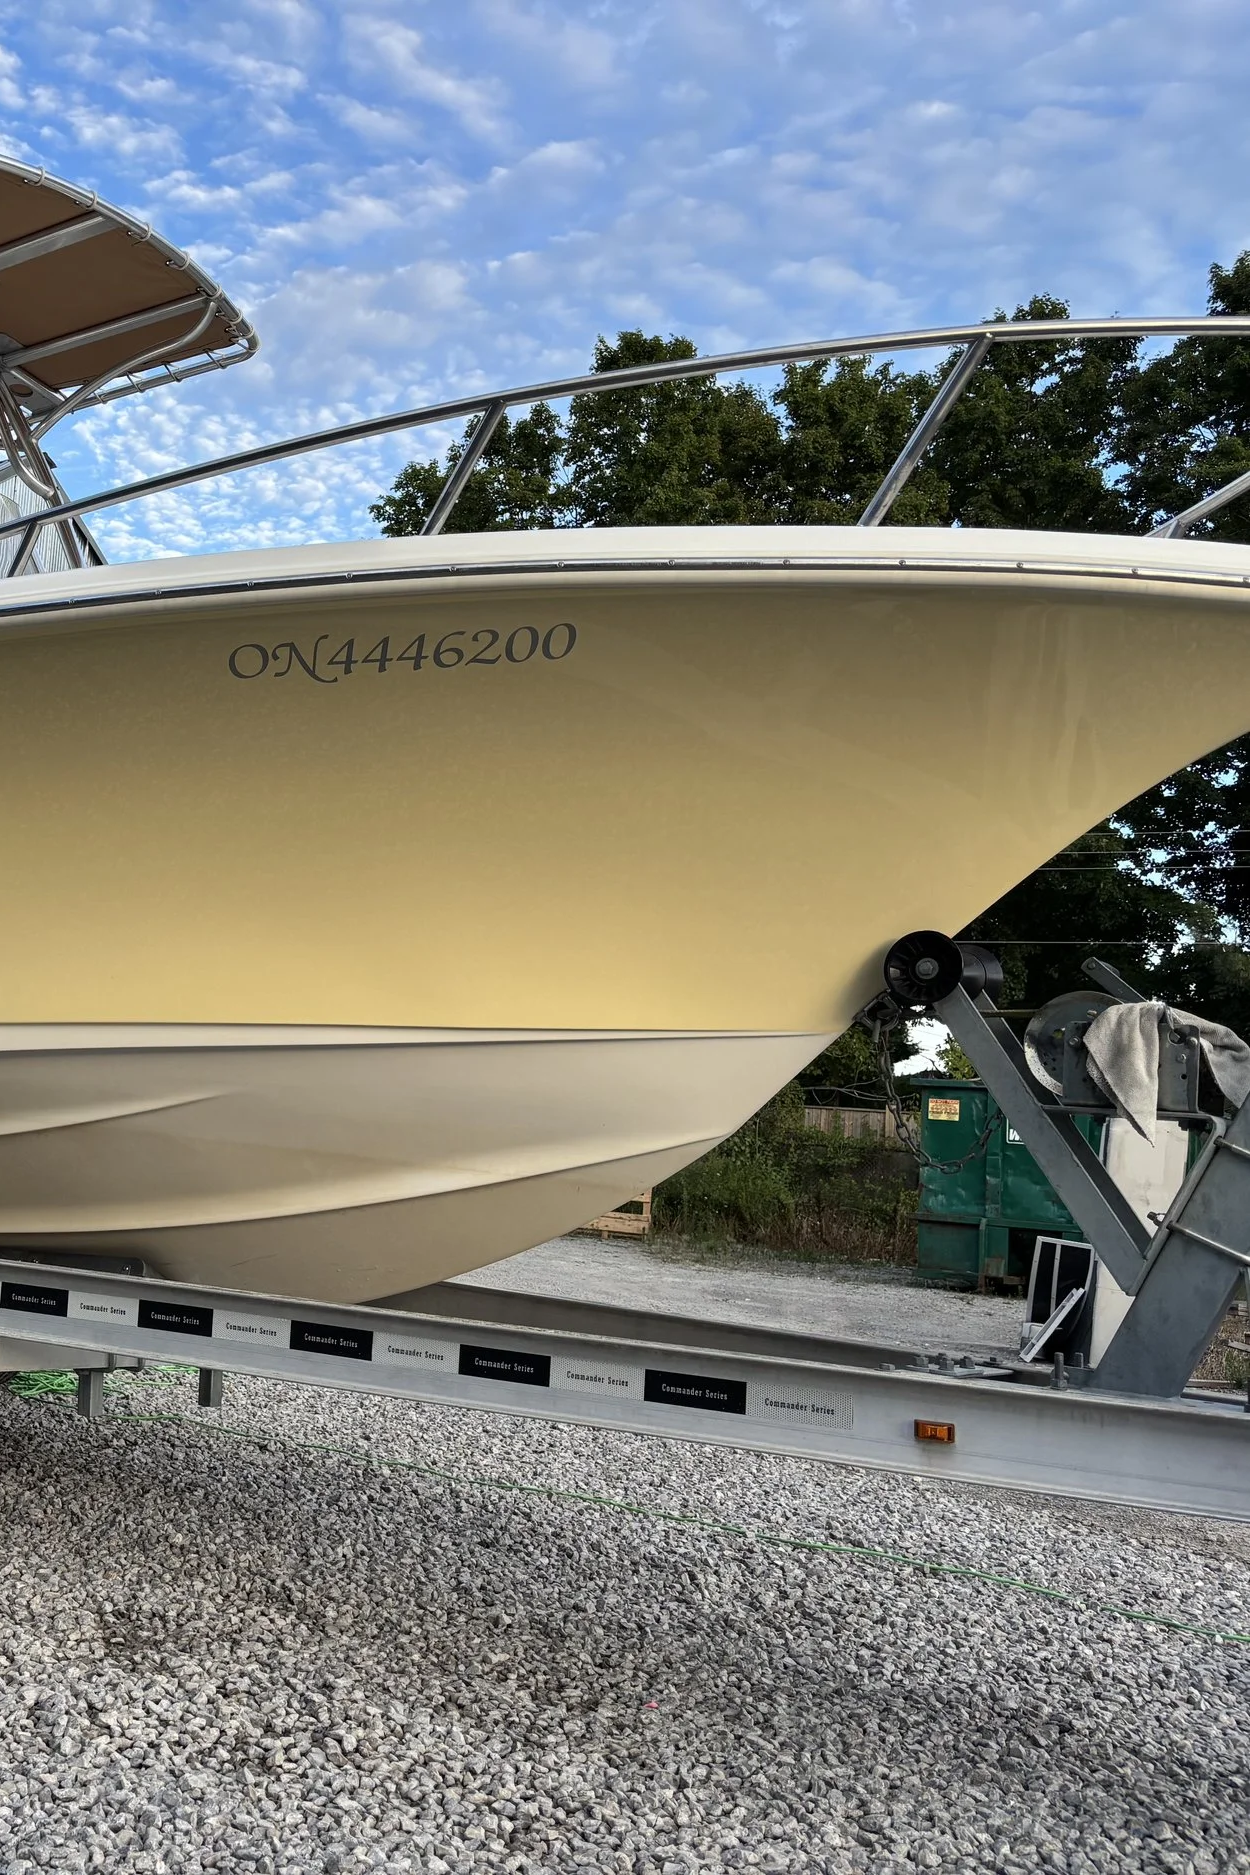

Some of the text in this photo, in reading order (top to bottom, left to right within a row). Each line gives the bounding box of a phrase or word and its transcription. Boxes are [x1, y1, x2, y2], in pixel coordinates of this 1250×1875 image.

[228, 622, 577, 684] ON4446200
[12, 1293, 56, 1306] Commander Series
[80, 1302, 126, 1316] Commander Series
[150, 1312, 199, 1325] Commander Series
[226, 1322, 277, 1336] Commander Series
[304, 1333, 358, 1348] Commander Series
[387, 1345, 444, 1360] Commander Series
[474, 1358, 534, 1373] Commander Series
[566, 1370, 628, 1387] Commander Series
[662, 1384, 728, 1400] Commander Series
[764, 1398, 834, 1416] Commander Series
